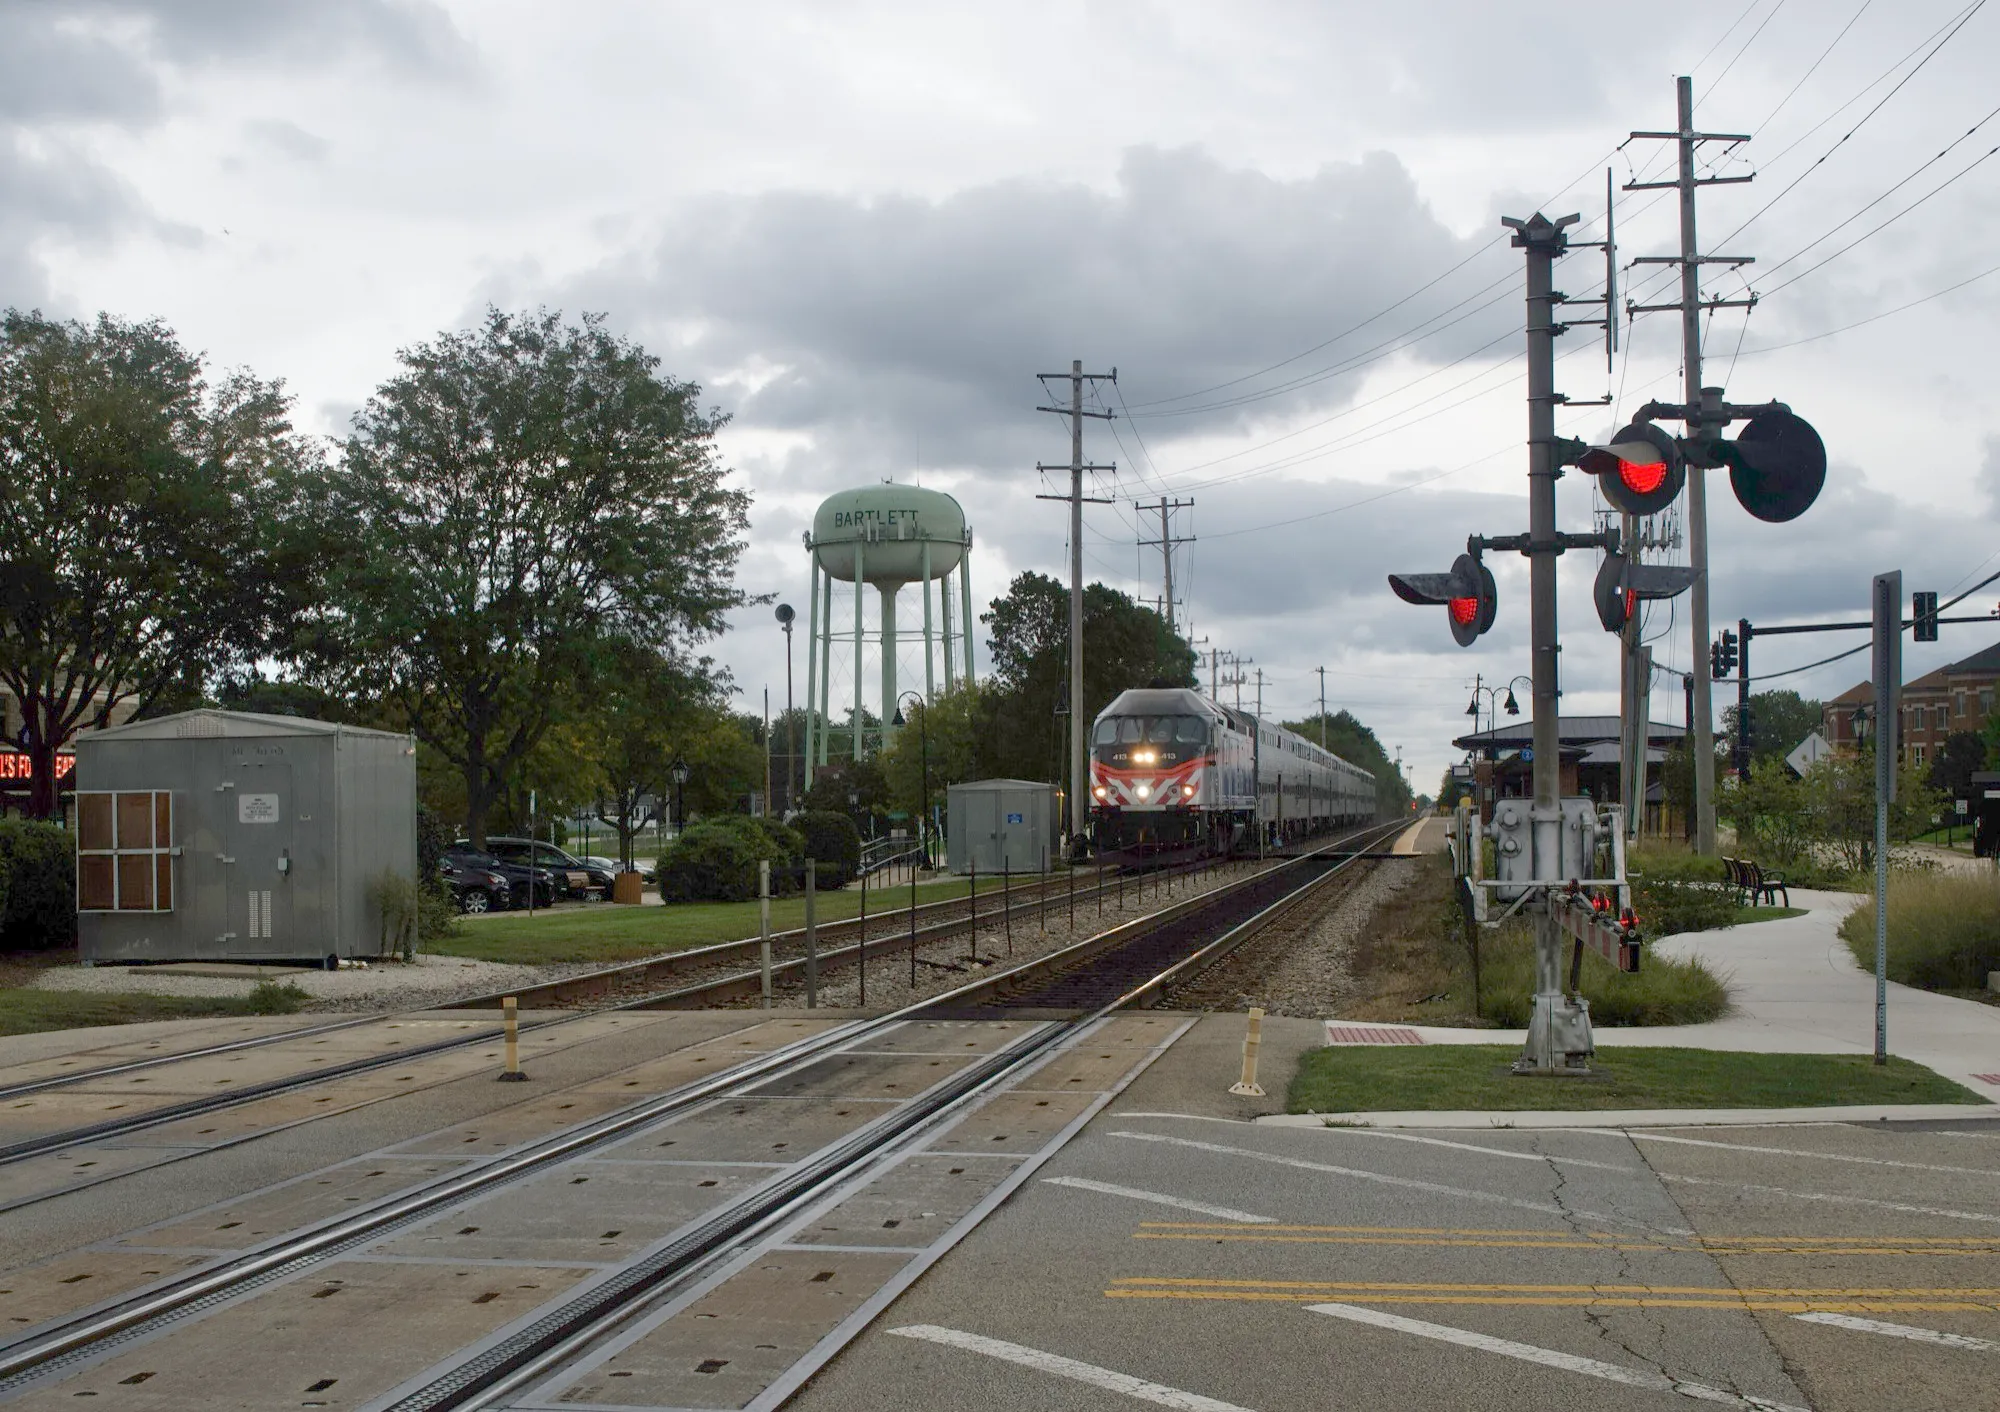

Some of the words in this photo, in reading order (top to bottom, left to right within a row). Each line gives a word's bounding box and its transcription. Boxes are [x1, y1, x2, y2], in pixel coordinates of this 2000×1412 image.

[835, 510, 918, 528] BARTLETT
[1112, 753, 1127, 761] 413
[1161, 752, 1177, 760] 413
